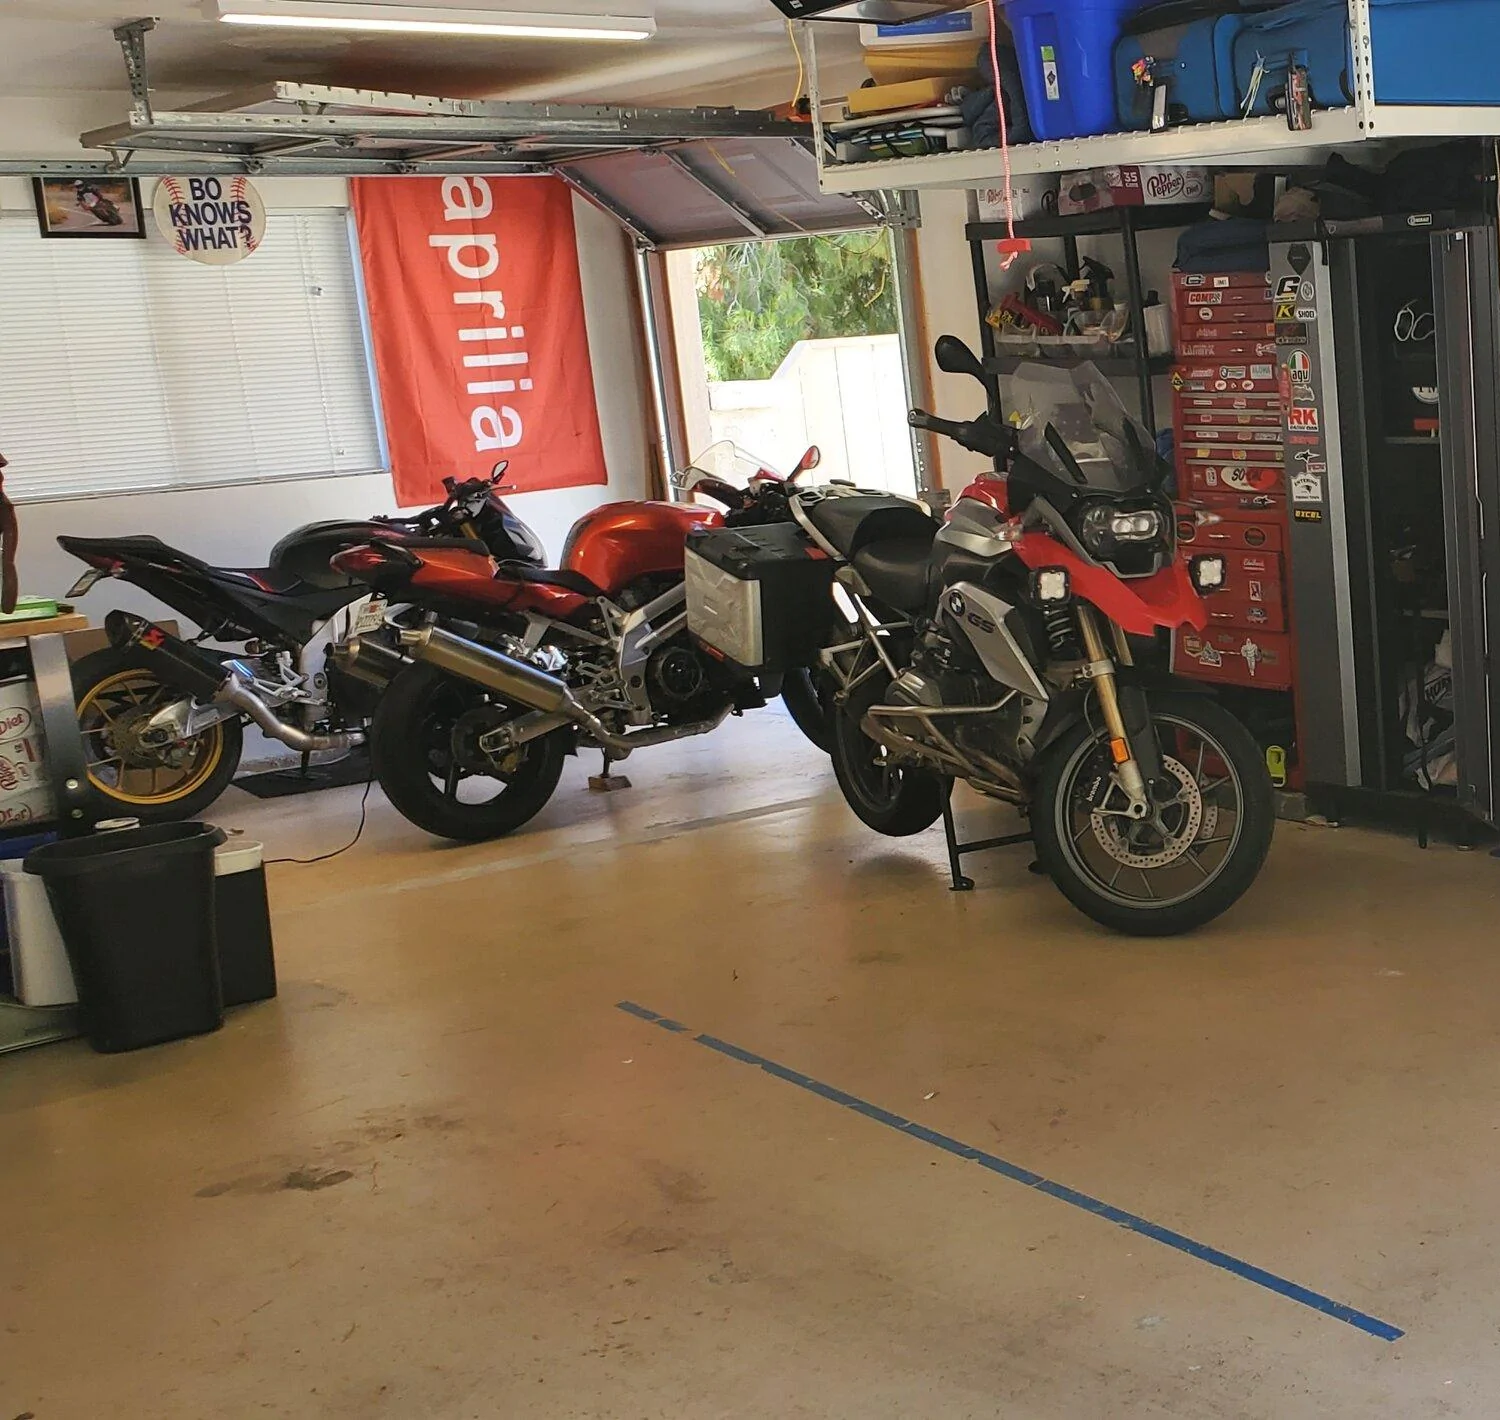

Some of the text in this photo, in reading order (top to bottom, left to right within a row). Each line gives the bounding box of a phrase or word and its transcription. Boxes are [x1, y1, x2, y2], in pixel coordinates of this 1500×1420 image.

[189, 177, 222, 200] BO
[1124, 172, 1138, 183] 35
[1147, 176, 1182, 198] Pepper
[1159, 173, 1172, 184] Dr
[169, 201, 252, 227] KNOWS
[178, 224, 253, 251] WHAT?
[428, 176, 533, 452] aprilia
[1292, 370, 1308, 382] agv
[1290, 409, 1317, 425] RK
